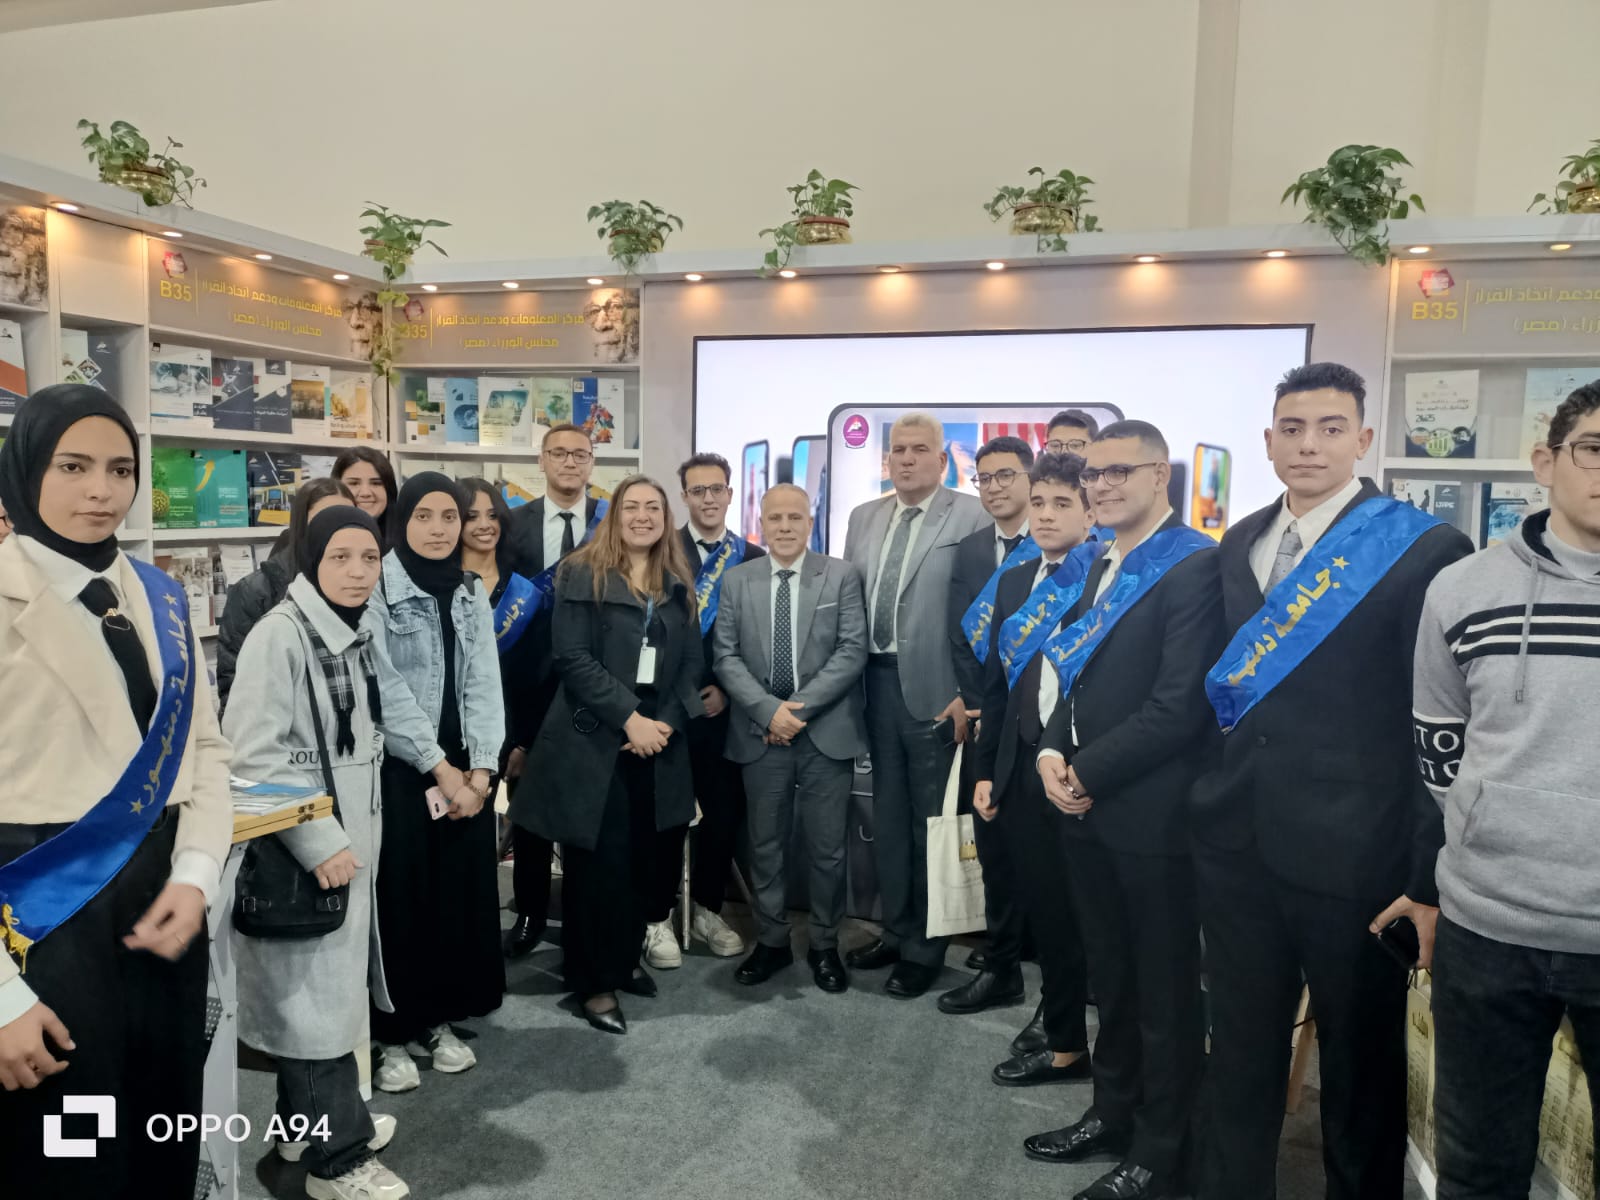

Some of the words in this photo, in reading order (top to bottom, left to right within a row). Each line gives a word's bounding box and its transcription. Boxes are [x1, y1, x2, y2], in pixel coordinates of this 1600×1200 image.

[160, 280, 193, 302] B35
[1411, 301, 1458, 321] B35
[495, 603, 525, 640] جامع
[1262, 568, 1341, 639] جامعة
[1003, 602, 1052, 649] جامعة
[168, 609, 190, 696] جامعة
[143, 698, 183, 807] دمنهور
[1412, 724, 1460, 753] TO
